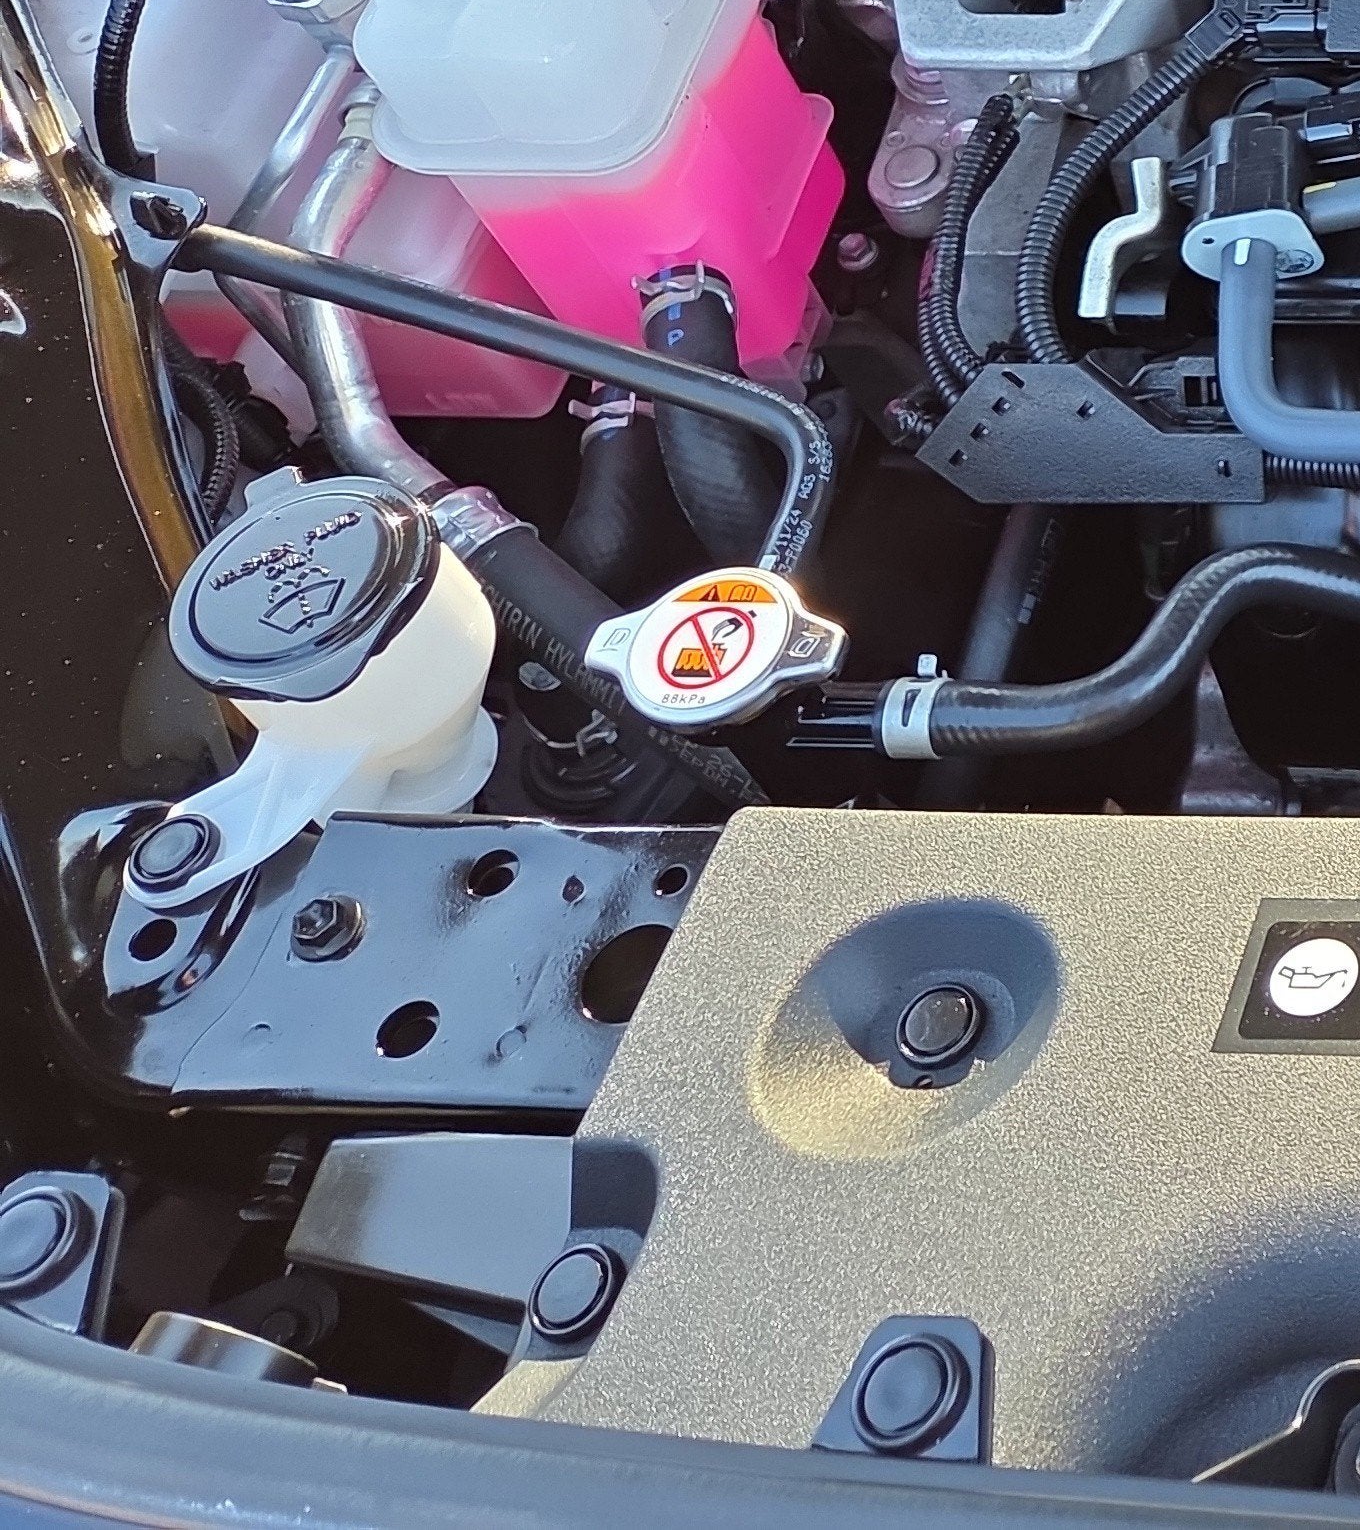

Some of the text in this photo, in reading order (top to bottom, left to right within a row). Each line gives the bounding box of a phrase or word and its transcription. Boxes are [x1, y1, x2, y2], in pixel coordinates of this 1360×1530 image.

[209, 511, 363, 592] WASHER FLUID
[661, 693, 706, 705] 88kPa
